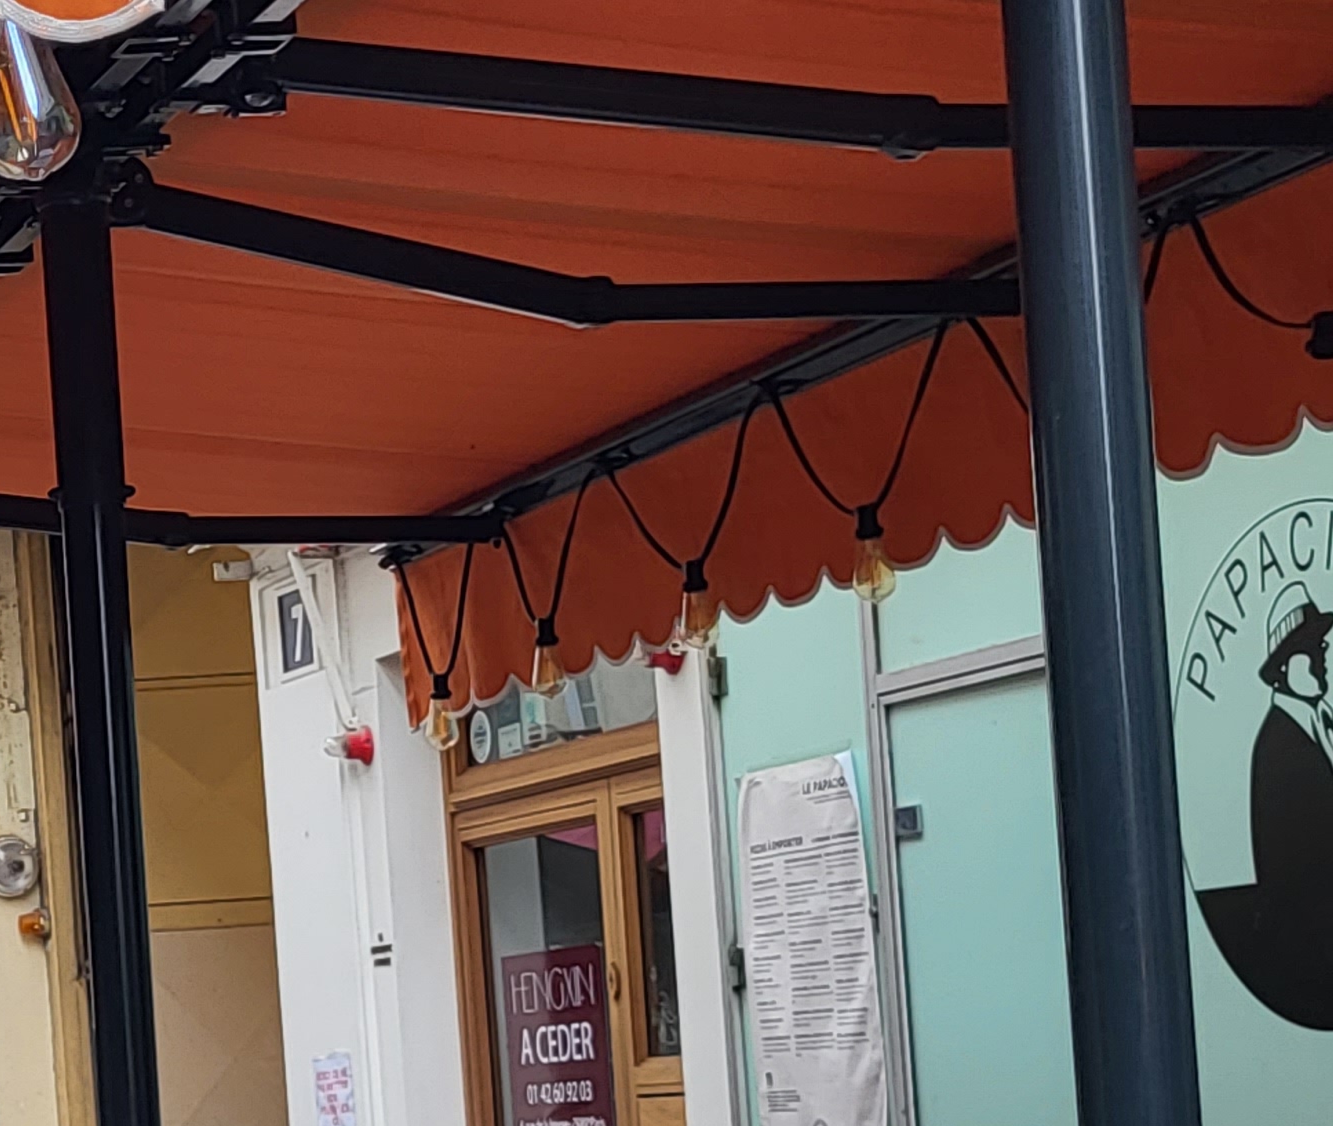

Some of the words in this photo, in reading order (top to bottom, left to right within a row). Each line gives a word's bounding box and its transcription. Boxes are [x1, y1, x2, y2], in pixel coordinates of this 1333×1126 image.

[521, 1028, 535, 1065] A
[536, 1021, 595, 1064] CEDER
[526, 1083, 538, 1105] 01
[540, 1083, 553, 1104] 42
[553, 1081, 565, 1104] 60
[566, 1081, 579, 1103] 92
[579, 1079, 593, 1102] 03
